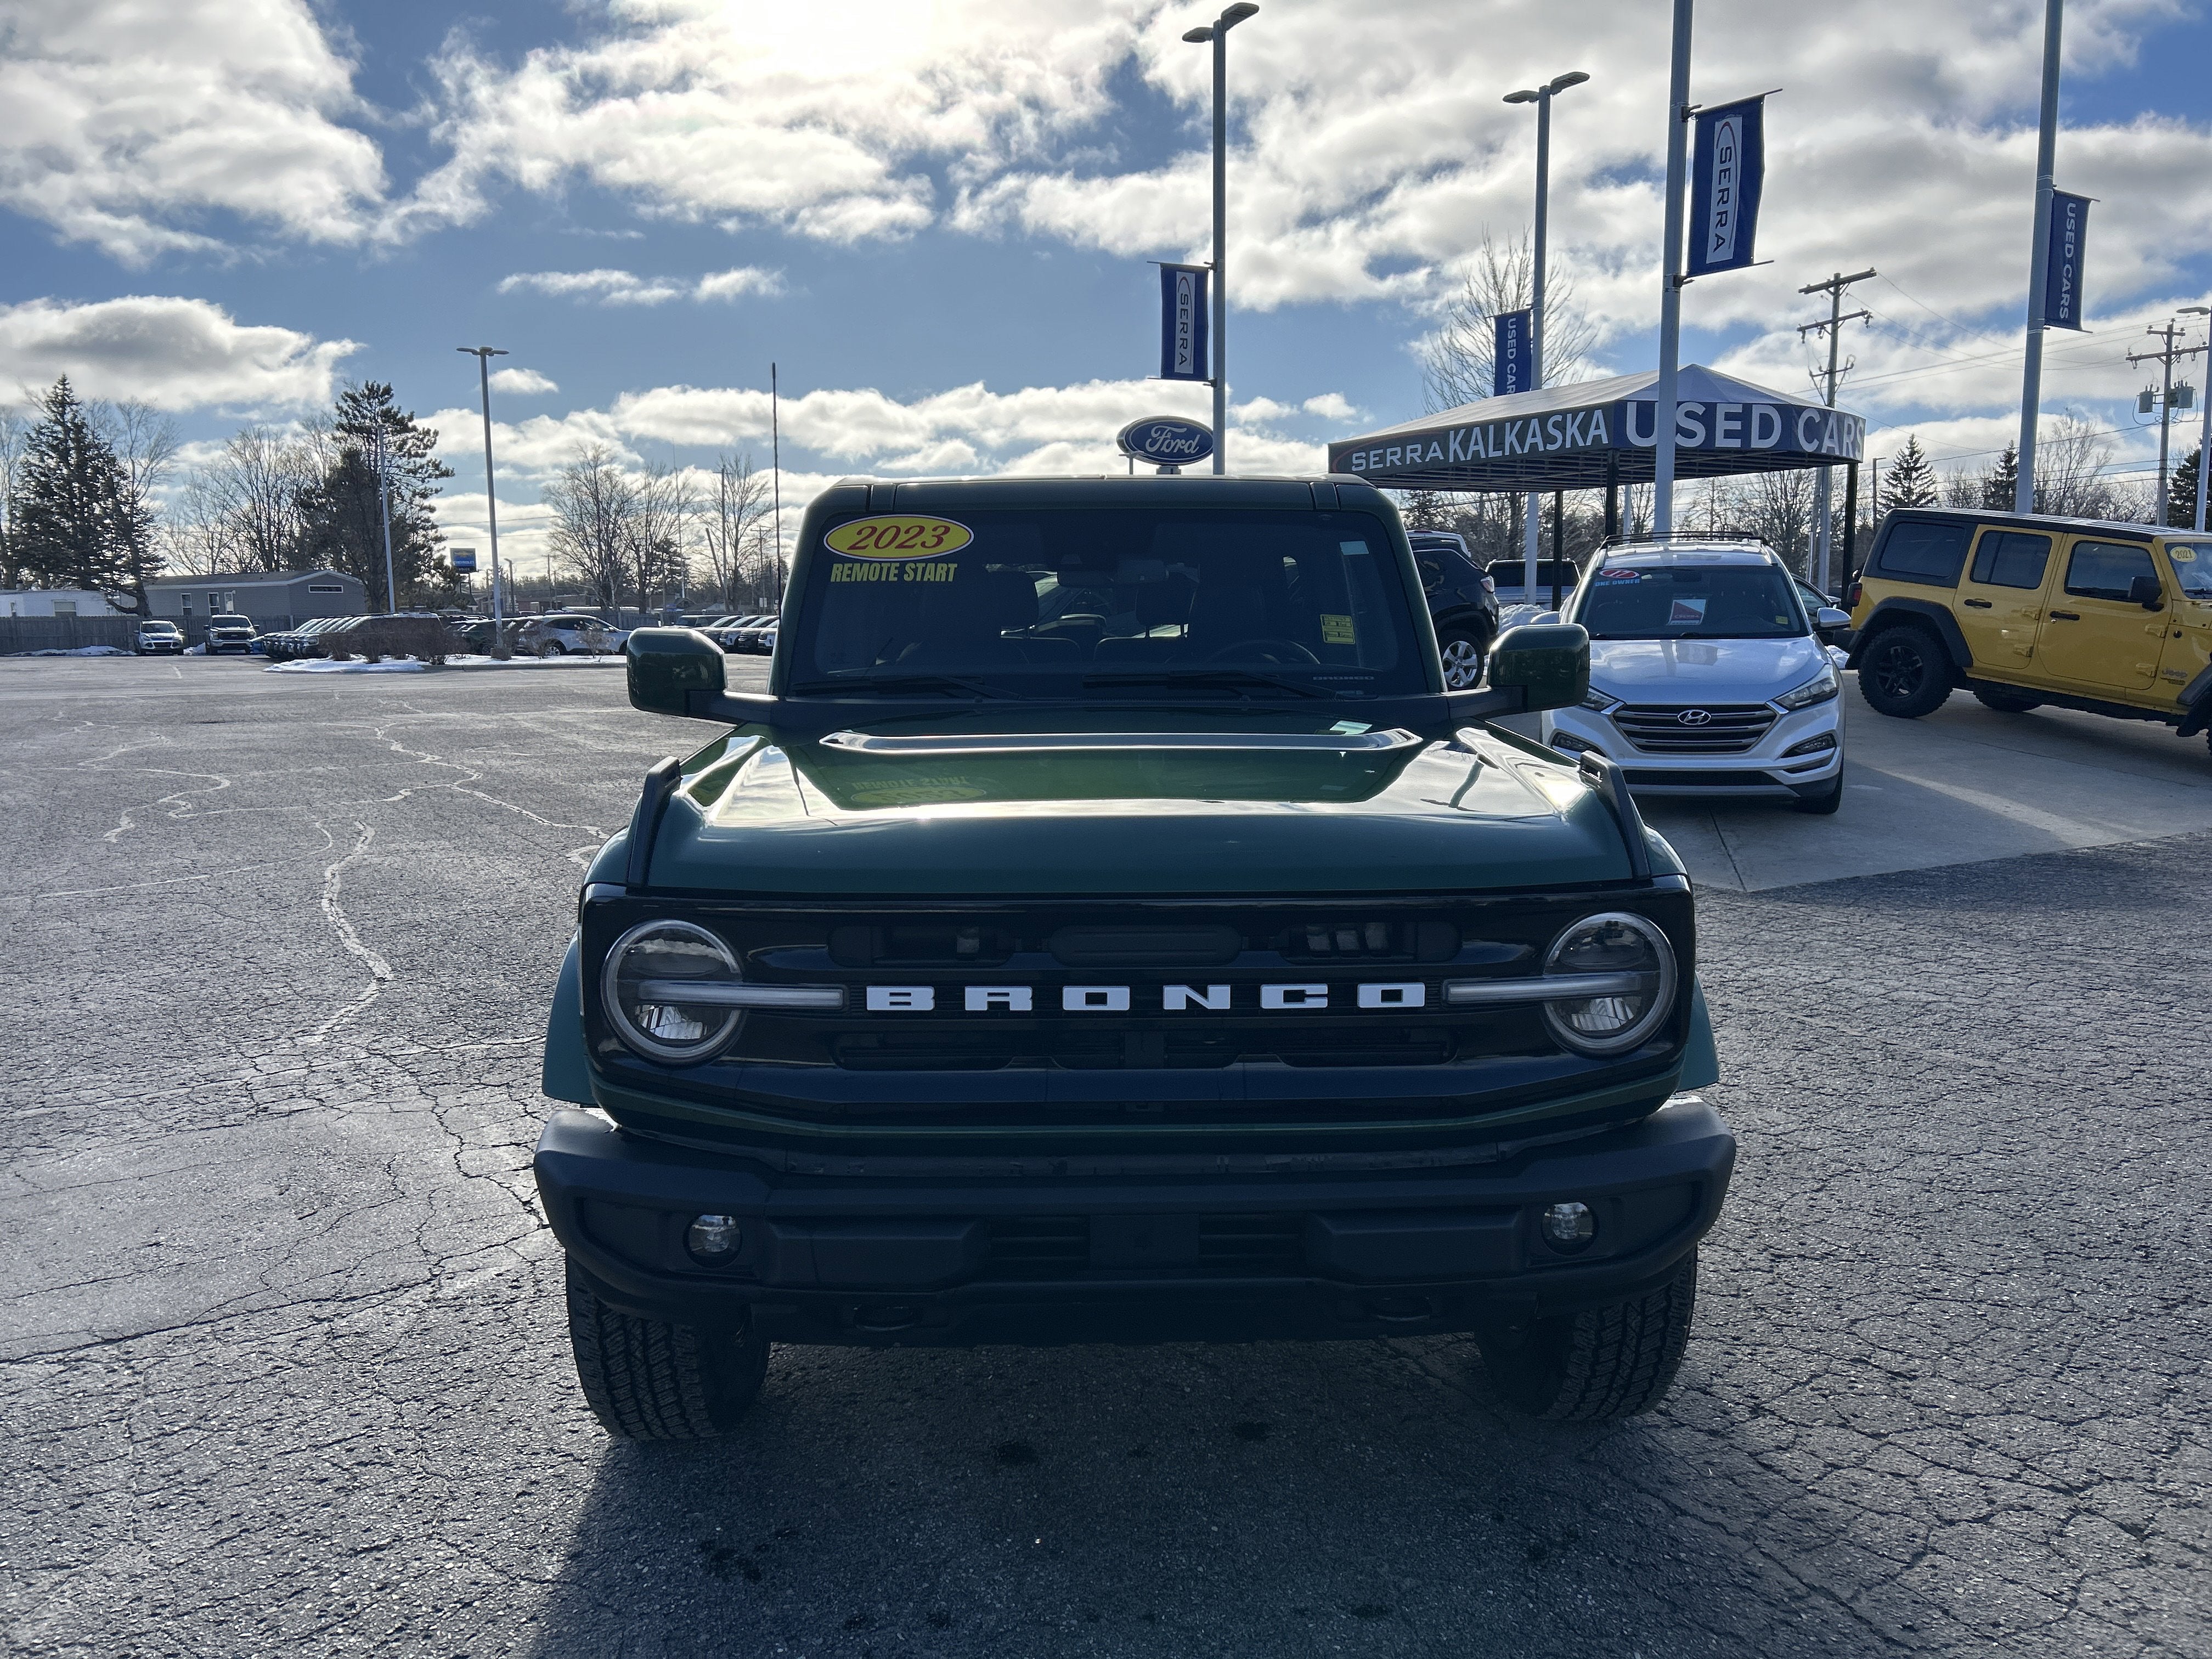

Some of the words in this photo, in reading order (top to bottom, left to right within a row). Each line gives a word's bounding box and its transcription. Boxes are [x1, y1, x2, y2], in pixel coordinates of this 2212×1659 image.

[1713, 145, 1732, 253] SERRA
[2064, 202, 2076, 258] USED
[2059, 263, 2073, 319] CARS
[1179, 292, 1189, 366] SERRA
[1507, 317, 1517, 359] USED
[1506, 363, 1517, 394] CAR
[1145, 425, 1201, 454] Ford
[1351, 441, 1444, 472] SERRA
[1448, 409, 1609, 463] KALKASKA
[1626, 401, 1782, 449] USED
[1797, 407, 1865, 458] CARS
[847, 524, 951, 551] 2023
[2175, 549, 2193, 559] 2021
[830, 562, 900, 582] REMOTE
[903, 562, 958, 582] START
[866, 981, 1426, 1012] BRONCO
